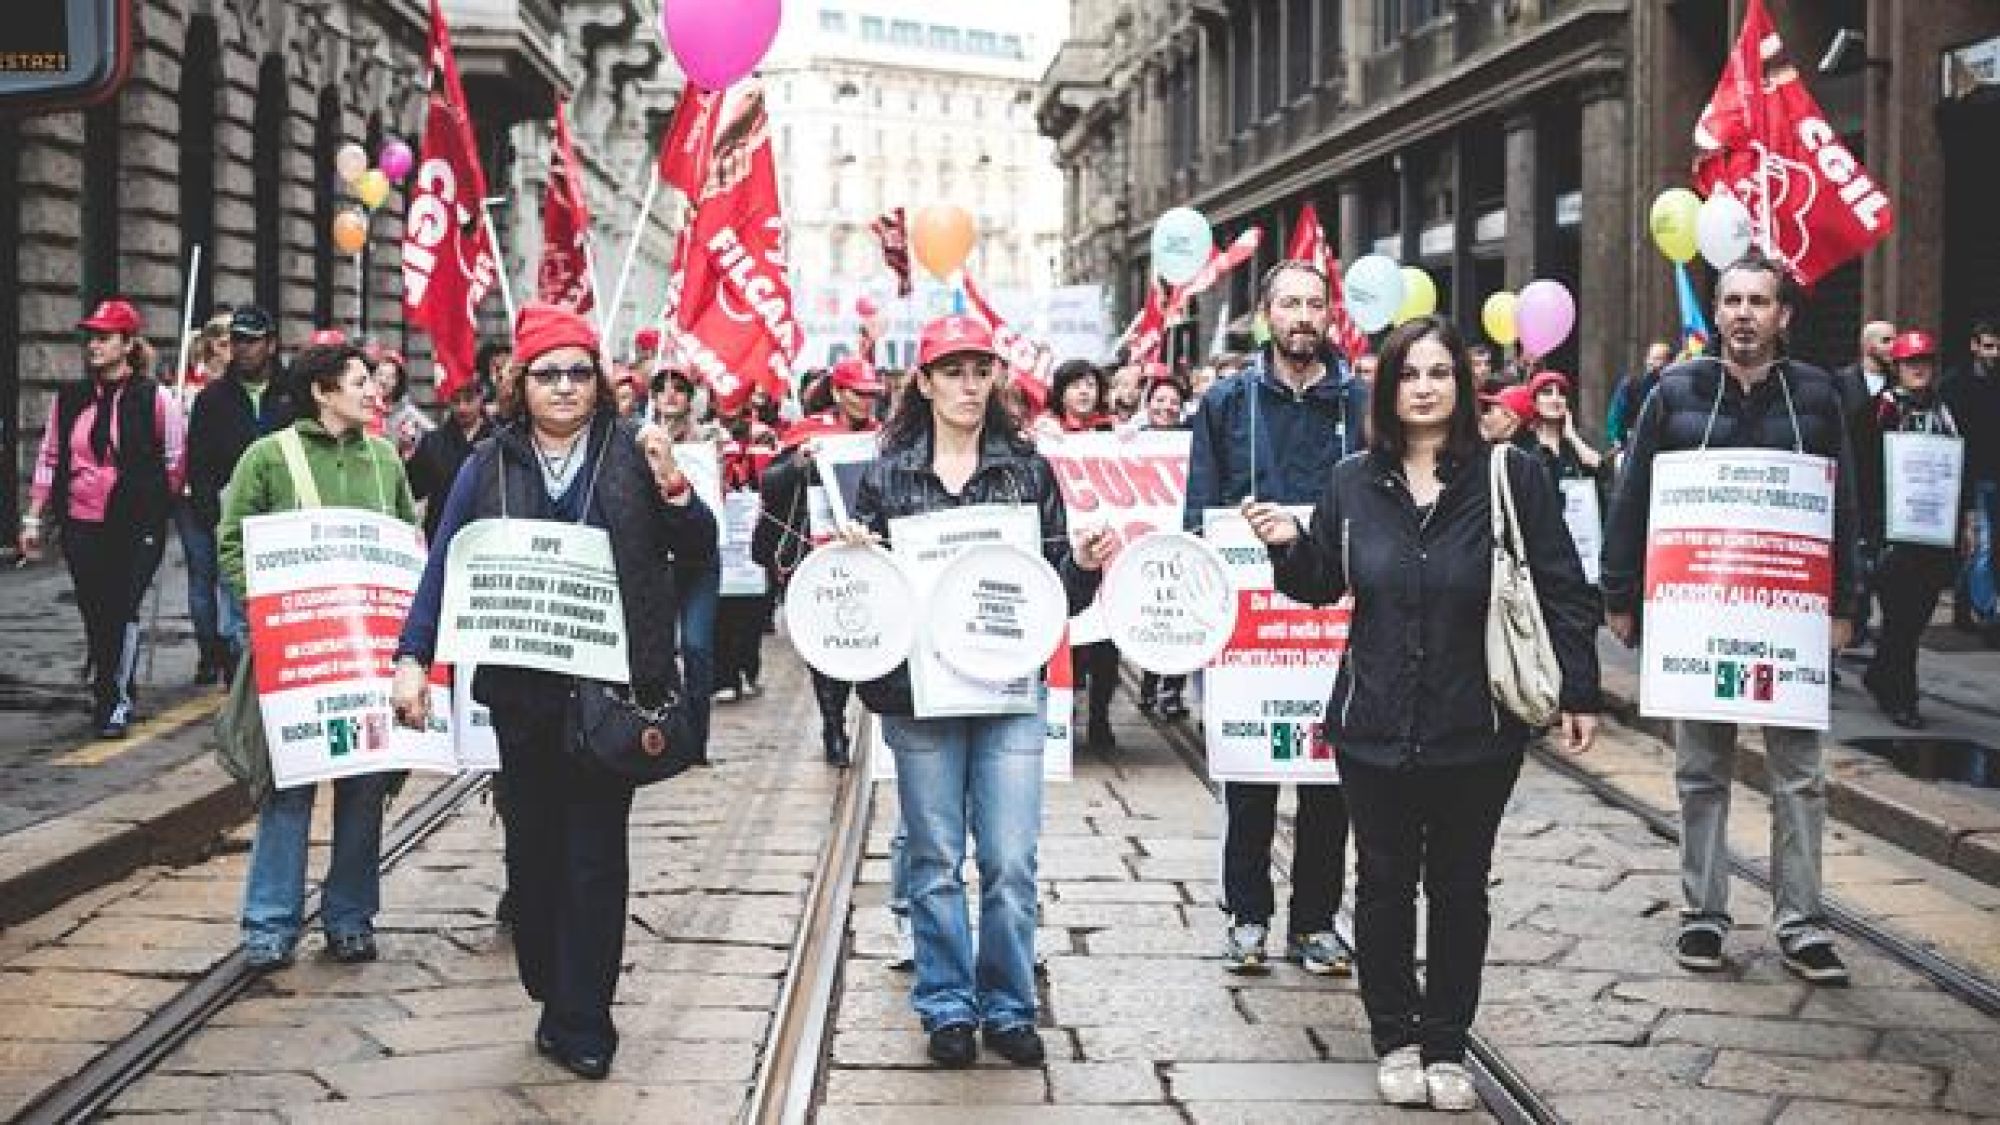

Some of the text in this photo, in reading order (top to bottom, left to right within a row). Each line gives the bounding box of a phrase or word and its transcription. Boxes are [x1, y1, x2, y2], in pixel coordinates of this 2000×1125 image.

[1799, 116, 1890, 231] CGIL
[829, 566, 850, 579] IL
[471, 573, 513, 591] BASTA
[515, 576, 549, 593] CON
[557, 583, 614, 604] RICATTI
[1156, 587, 1178, 602] LE
[469, 596, 606, 624] VOGLIAMO IL RINNOVO
[456, 615, 620, 648] DEL CONTRATTO DI LAVORO
[489, 635, 575, 661] DEL TURISMO
[1717, 639, 1767, 658] TURISMO
[1662, 656, 1712, 675] RISORSA
[326, 694, 377, 711] TURISMO
[1273, 700, 1323, 717] TURISMO
[1222, 722, 1267, 737] RISORSA
